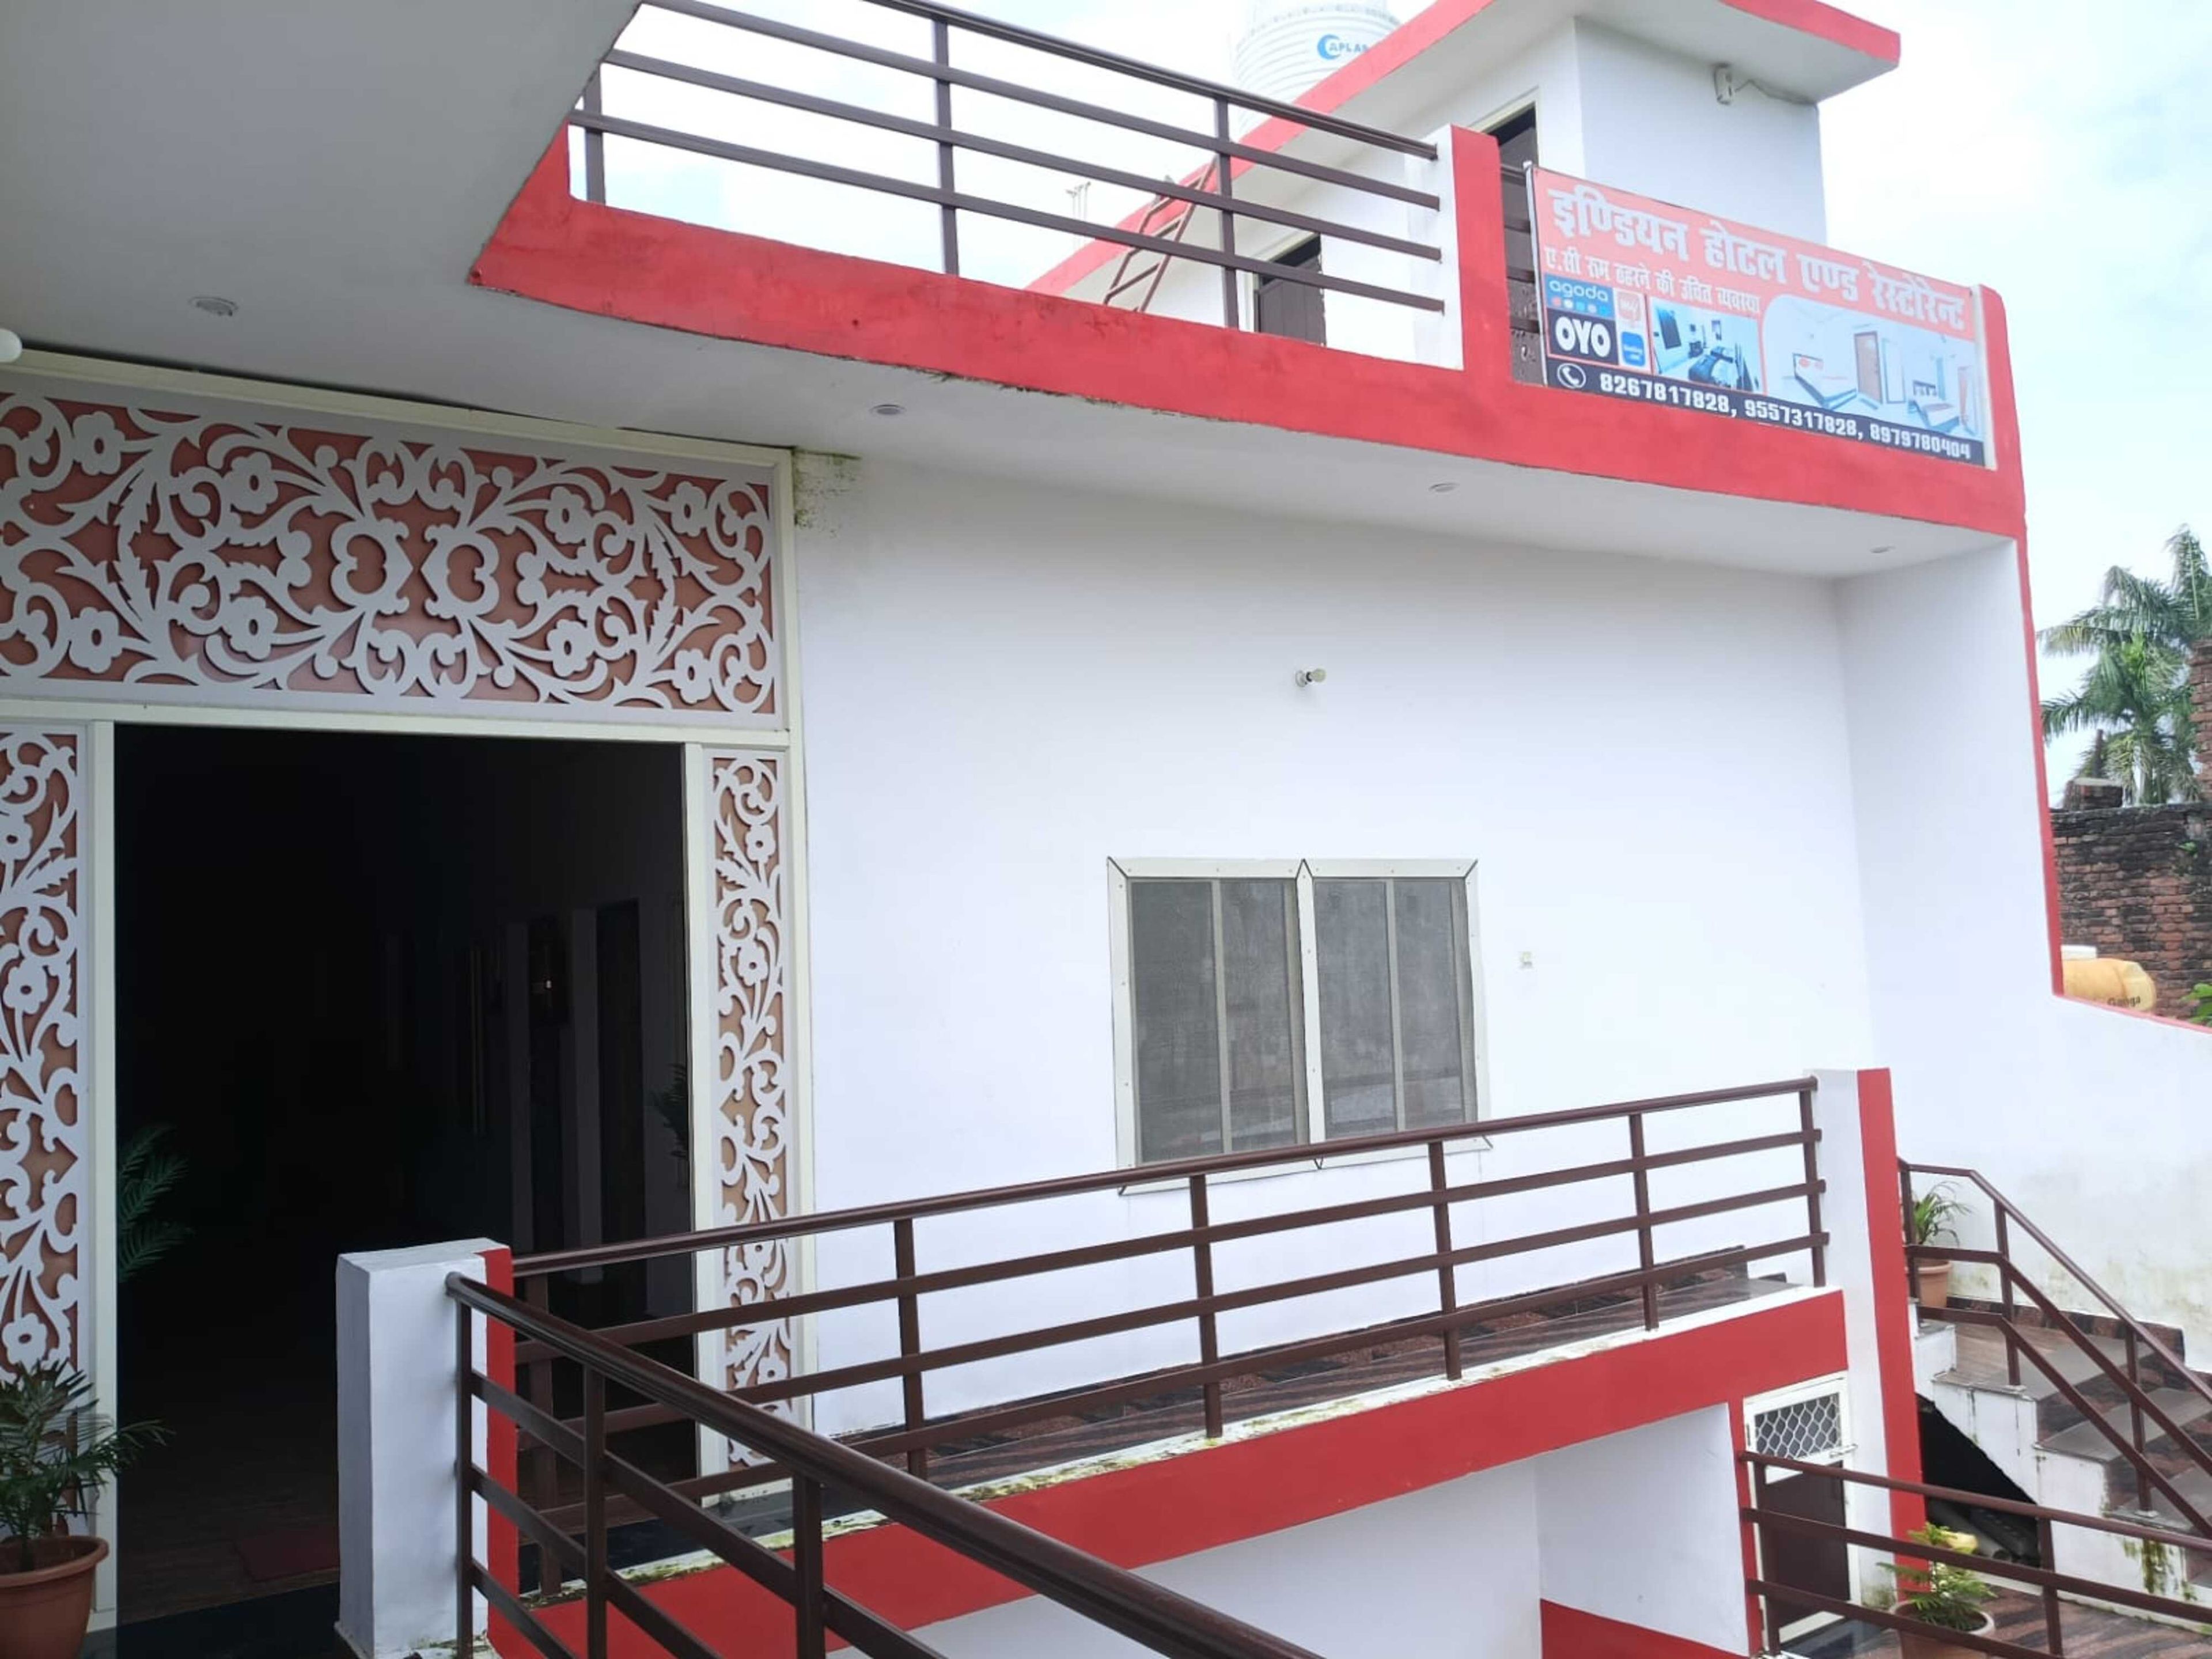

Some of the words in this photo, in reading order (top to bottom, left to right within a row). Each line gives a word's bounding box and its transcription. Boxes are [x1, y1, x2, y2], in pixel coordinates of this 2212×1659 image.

[1700, 221, 1786, 283] होटल
[1797, 254, 1859, 301] एण्ड
[1550, 280, 1609, 302] agoda
[1654, 269, 1675, 297] की
[1555, 316, 1611, 358] OYO
[1870, 423, 1971, 459] 8979780404
